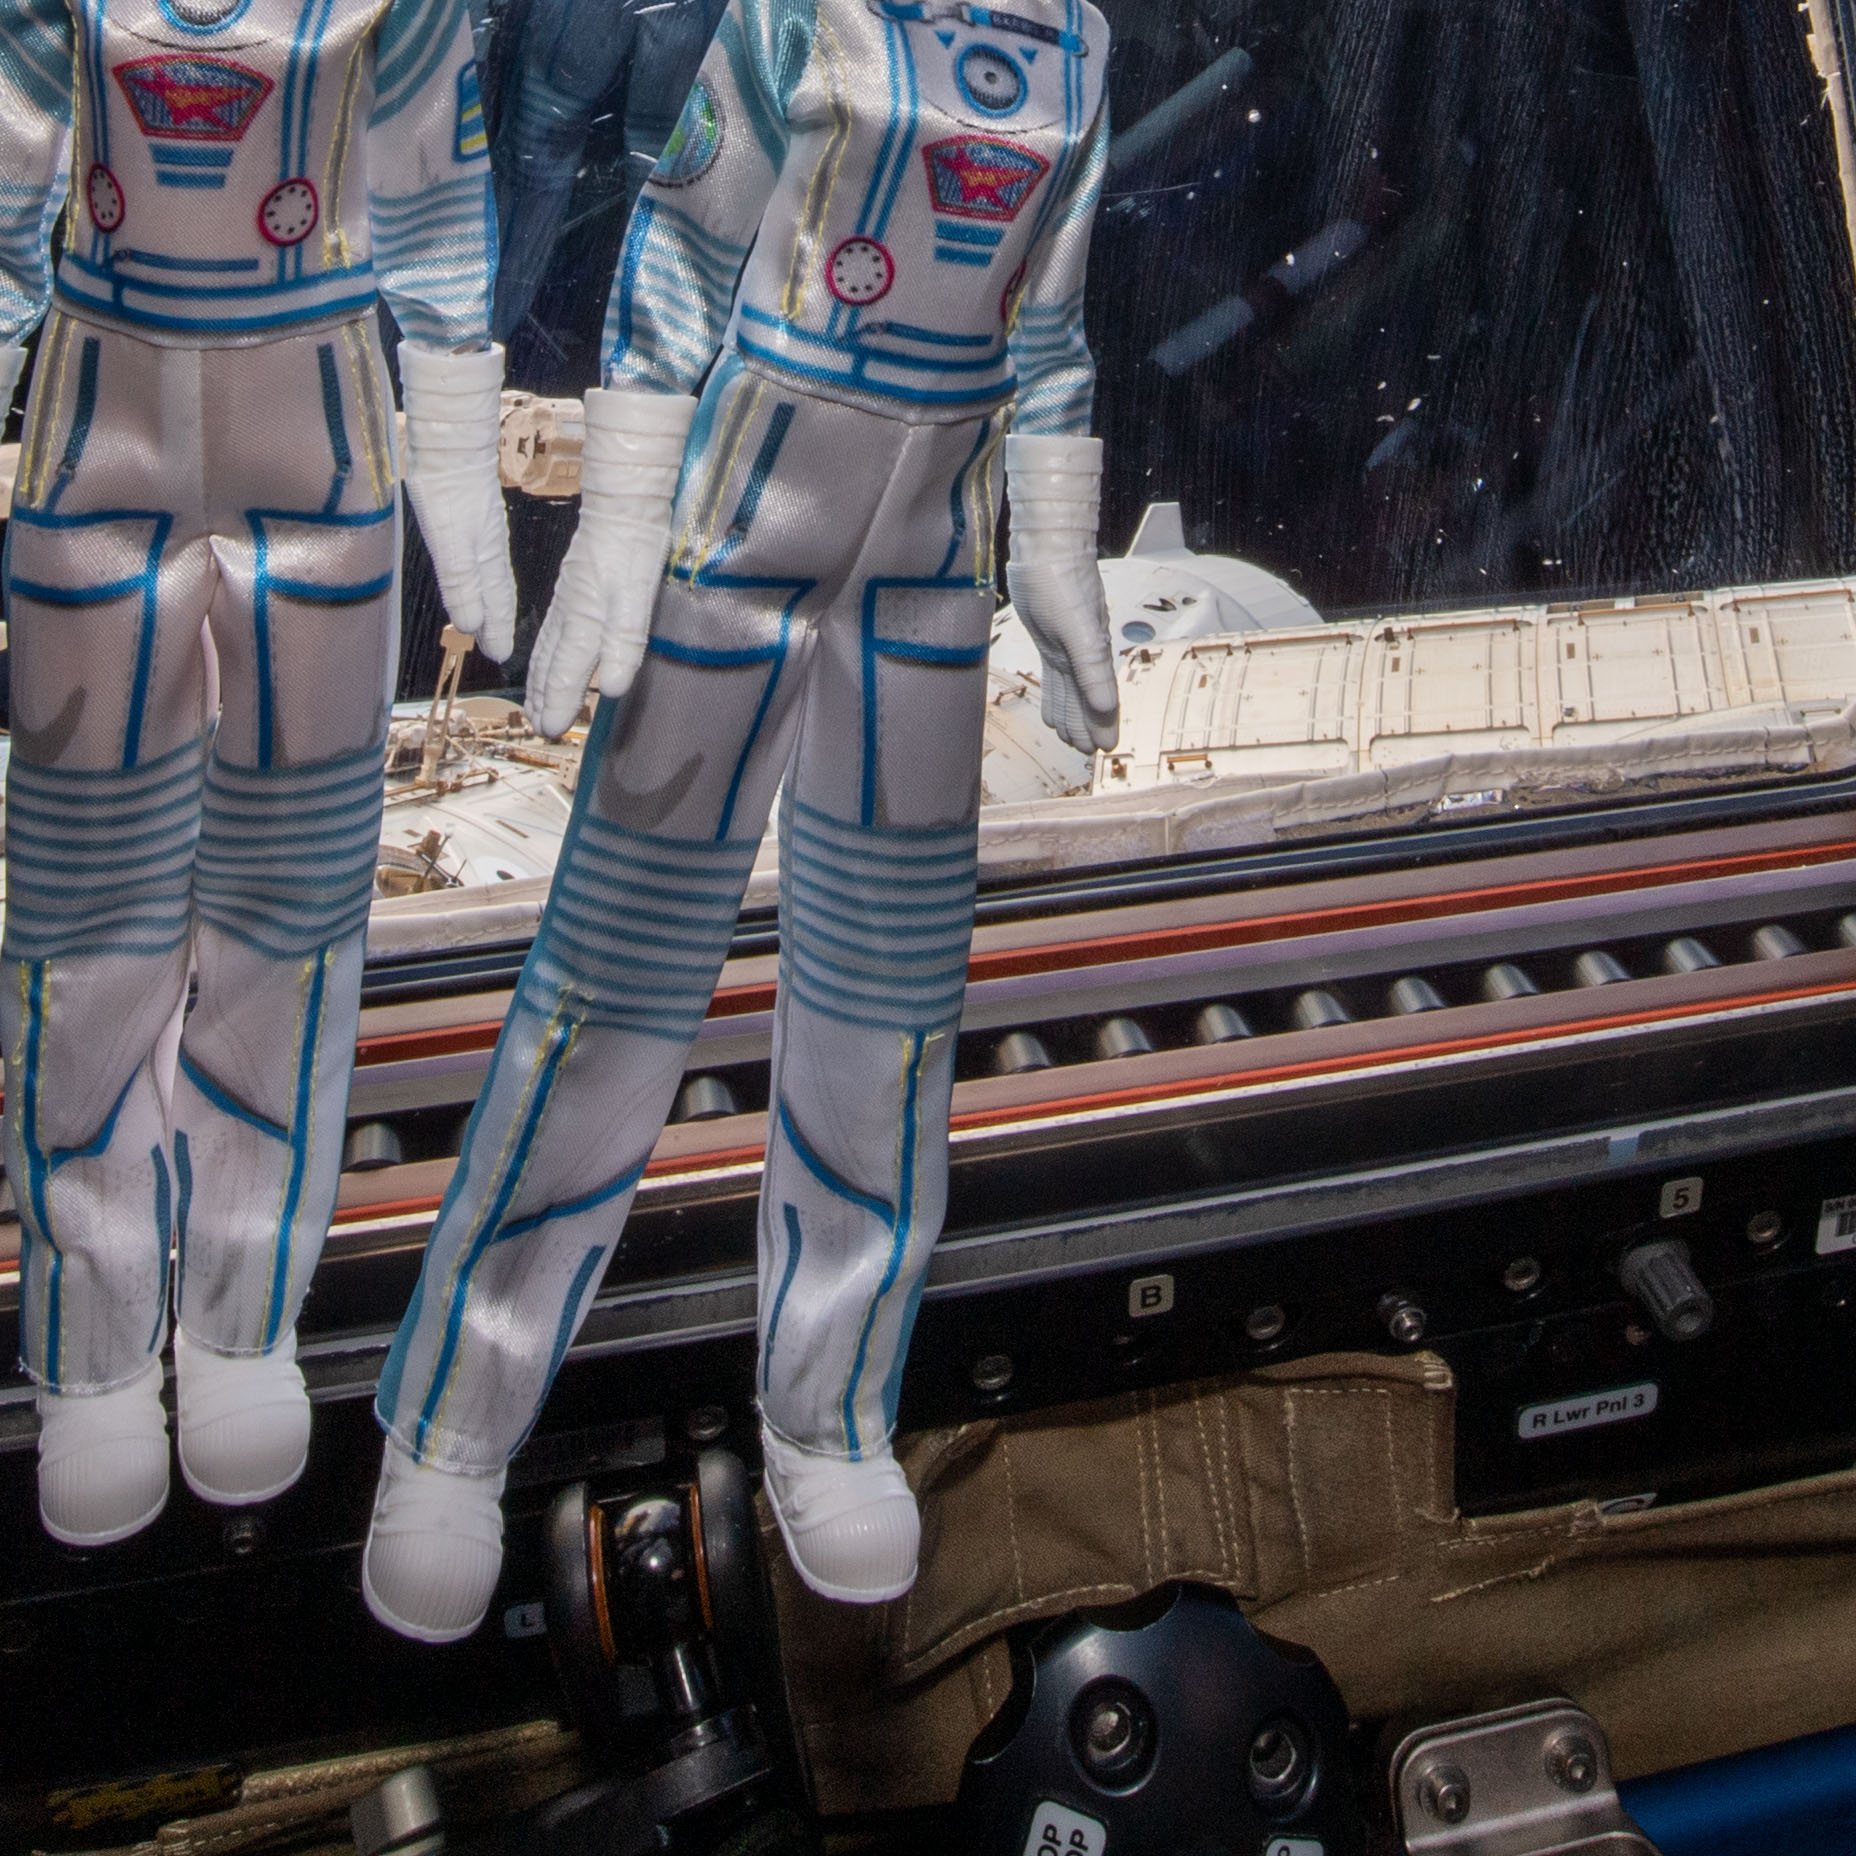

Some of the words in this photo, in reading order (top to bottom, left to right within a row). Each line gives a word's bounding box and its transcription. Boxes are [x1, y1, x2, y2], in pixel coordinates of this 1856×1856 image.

[1672, 1187, 1690, 1210] 5
[1140, 1284, 1163, 1309] B
[1532, 1413, 1547, 1428] R
[1552, 1406, 1591, 1424] Lwr
[1596, 1396, 1628, 1415] Pnl
[1632, 1393, 1645, 1408] 3
